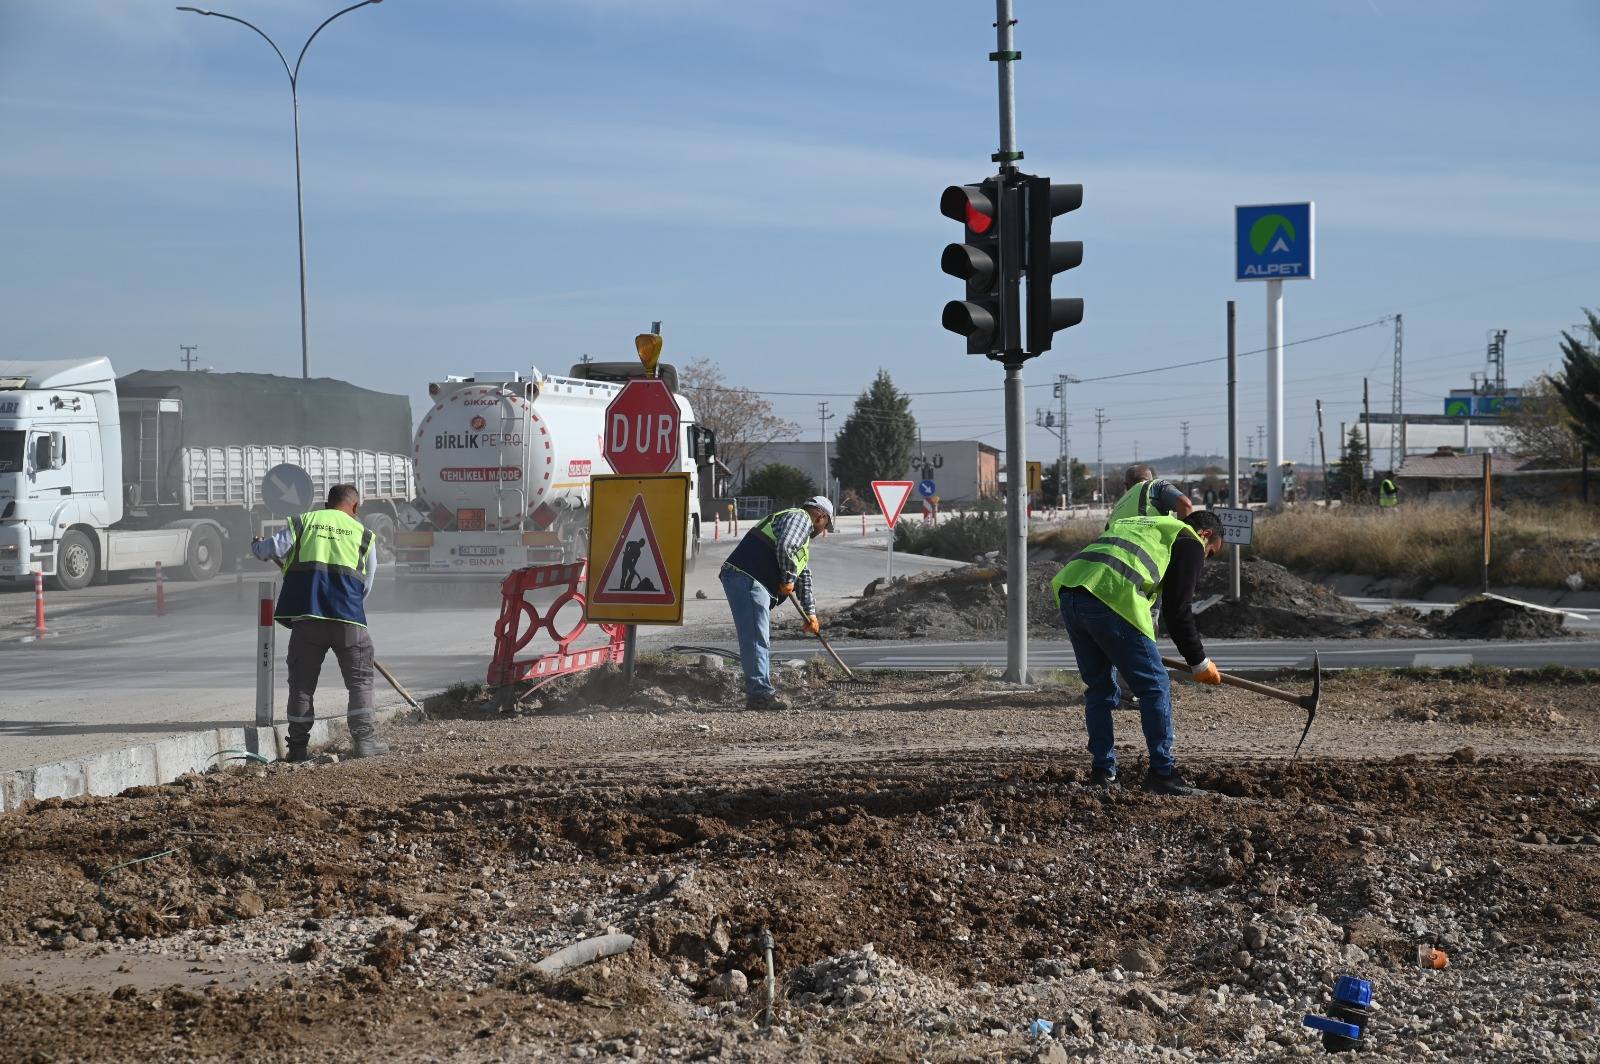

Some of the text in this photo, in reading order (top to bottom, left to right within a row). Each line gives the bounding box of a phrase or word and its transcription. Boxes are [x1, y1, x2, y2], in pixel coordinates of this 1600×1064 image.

[1244, 263, 1302, 275] ALPET
[435, 430, 479, 449] BİRLİK
[611, 414, 672, 453] DUR
[442, 468, 520, 480] TEHLİKELİ MADDE
